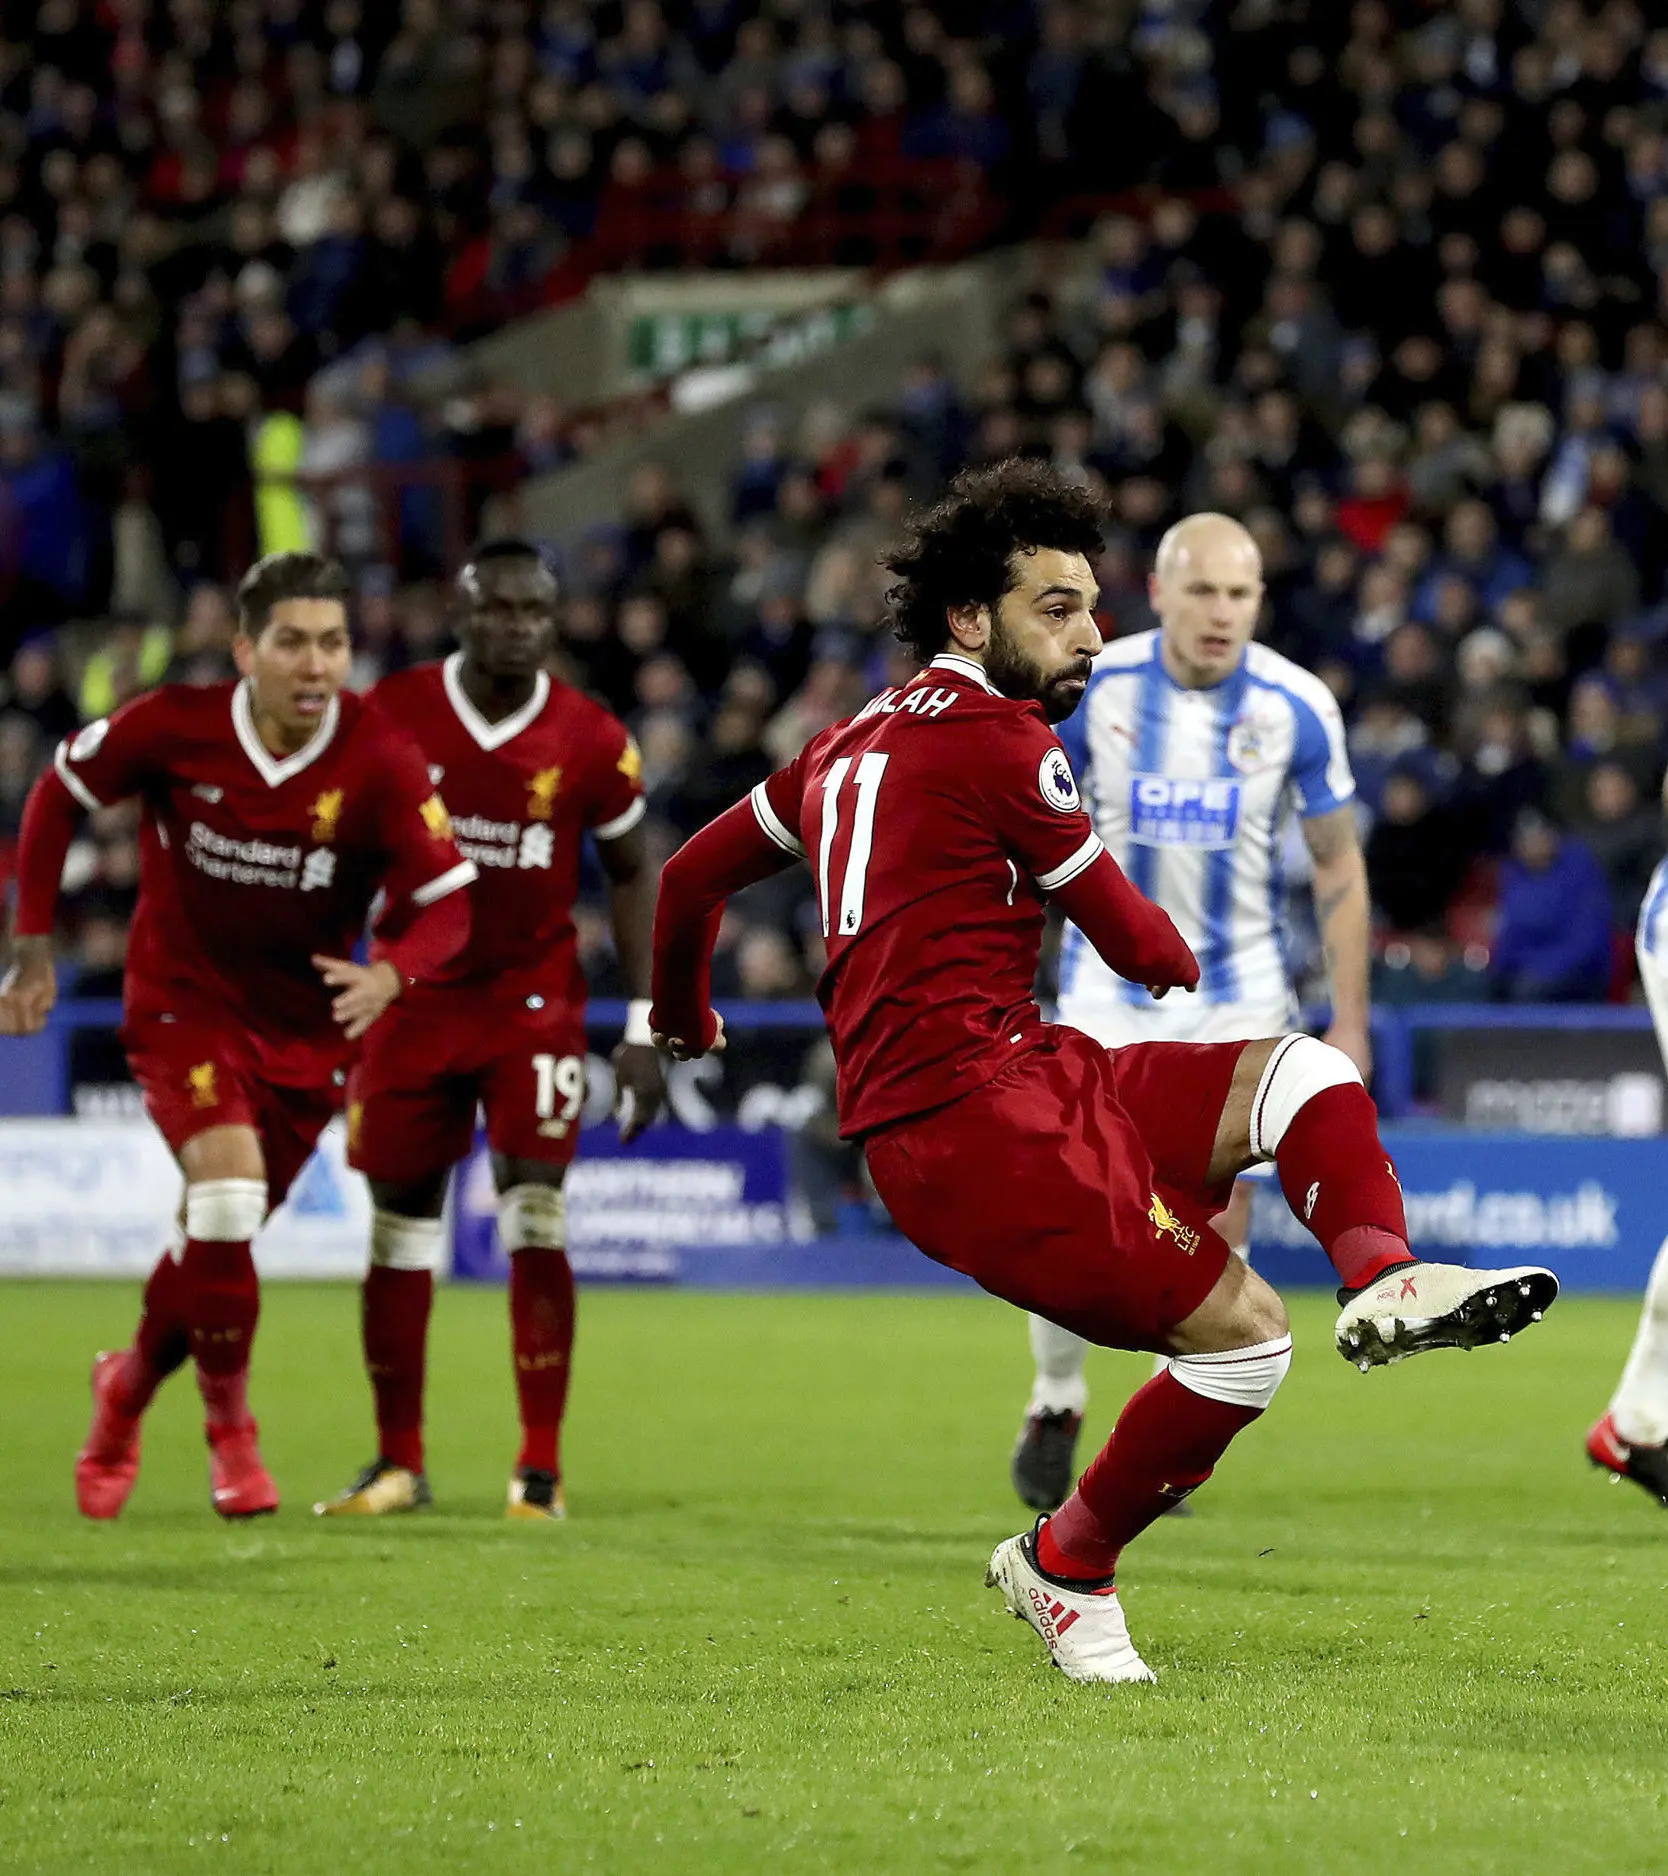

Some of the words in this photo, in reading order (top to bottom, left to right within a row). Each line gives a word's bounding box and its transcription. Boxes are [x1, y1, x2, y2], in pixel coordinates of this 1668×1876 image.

[849, 686, 959, 727] LAH
[1139, 780, 1229, 810] OPE
[189, 821, 300, 869] Standard
[818, 751, 890, 938] 11
[531, 1053, 586, 1119] 19
[1028, 1587, 1058, 1649] adidas
